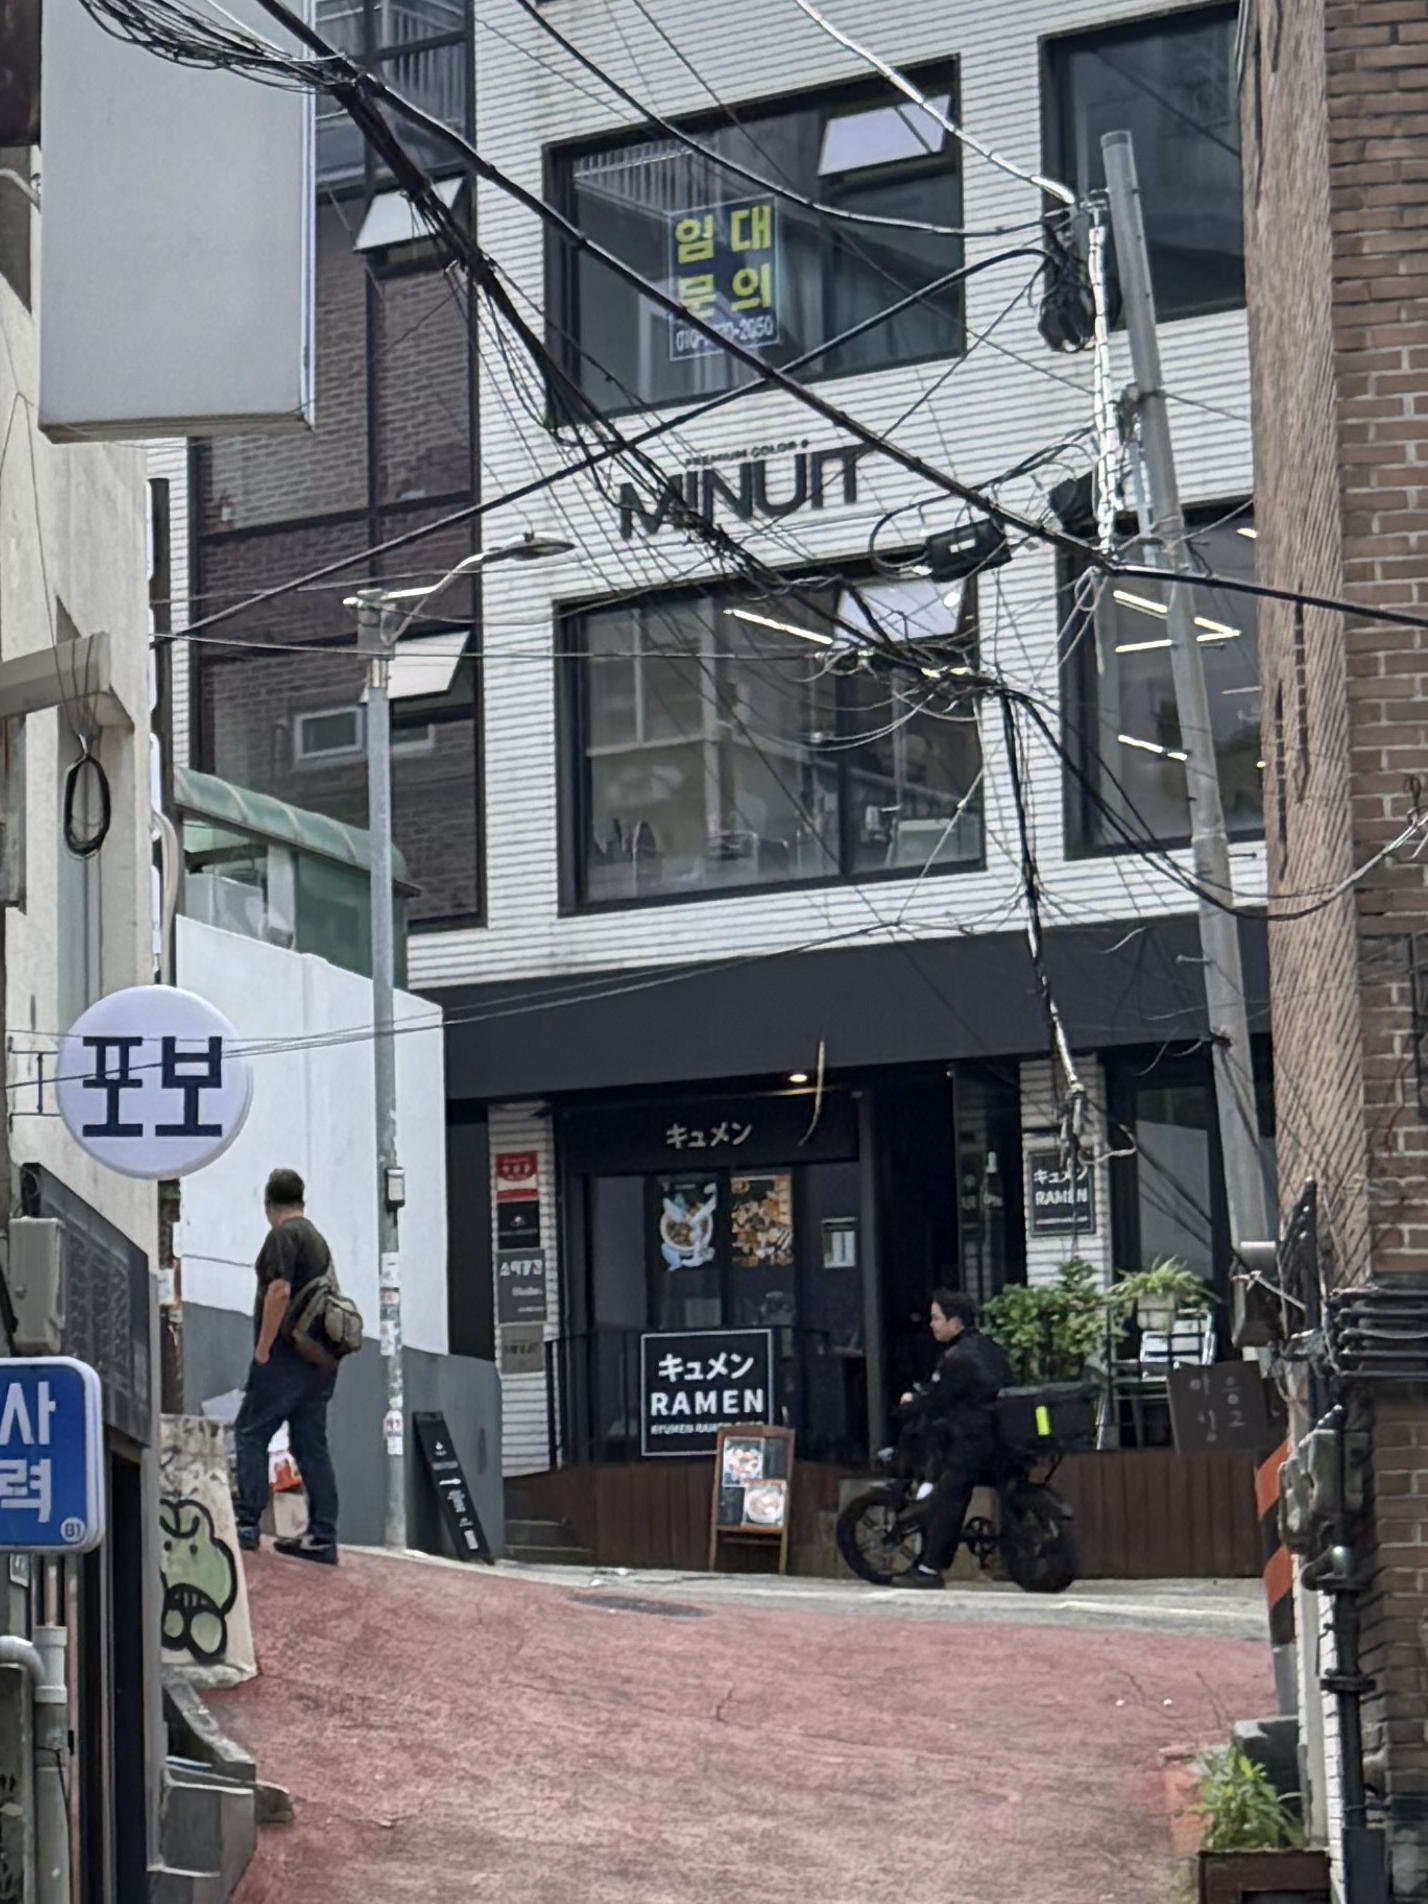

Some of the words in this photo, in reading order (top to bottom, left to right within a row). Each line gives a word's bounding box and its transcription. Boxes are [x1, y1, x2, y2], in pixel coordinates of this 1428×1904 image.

[674, 205, 771, 264] 임대
[677, 263, 772, 320] 문의
[82, 1035, 223, 1138] 포보
[665, 1121, 753, 1149] キュメン
[657, 1352, 755, 1383] キュメン
[650, 1388, 765, 1417] RAMEN
